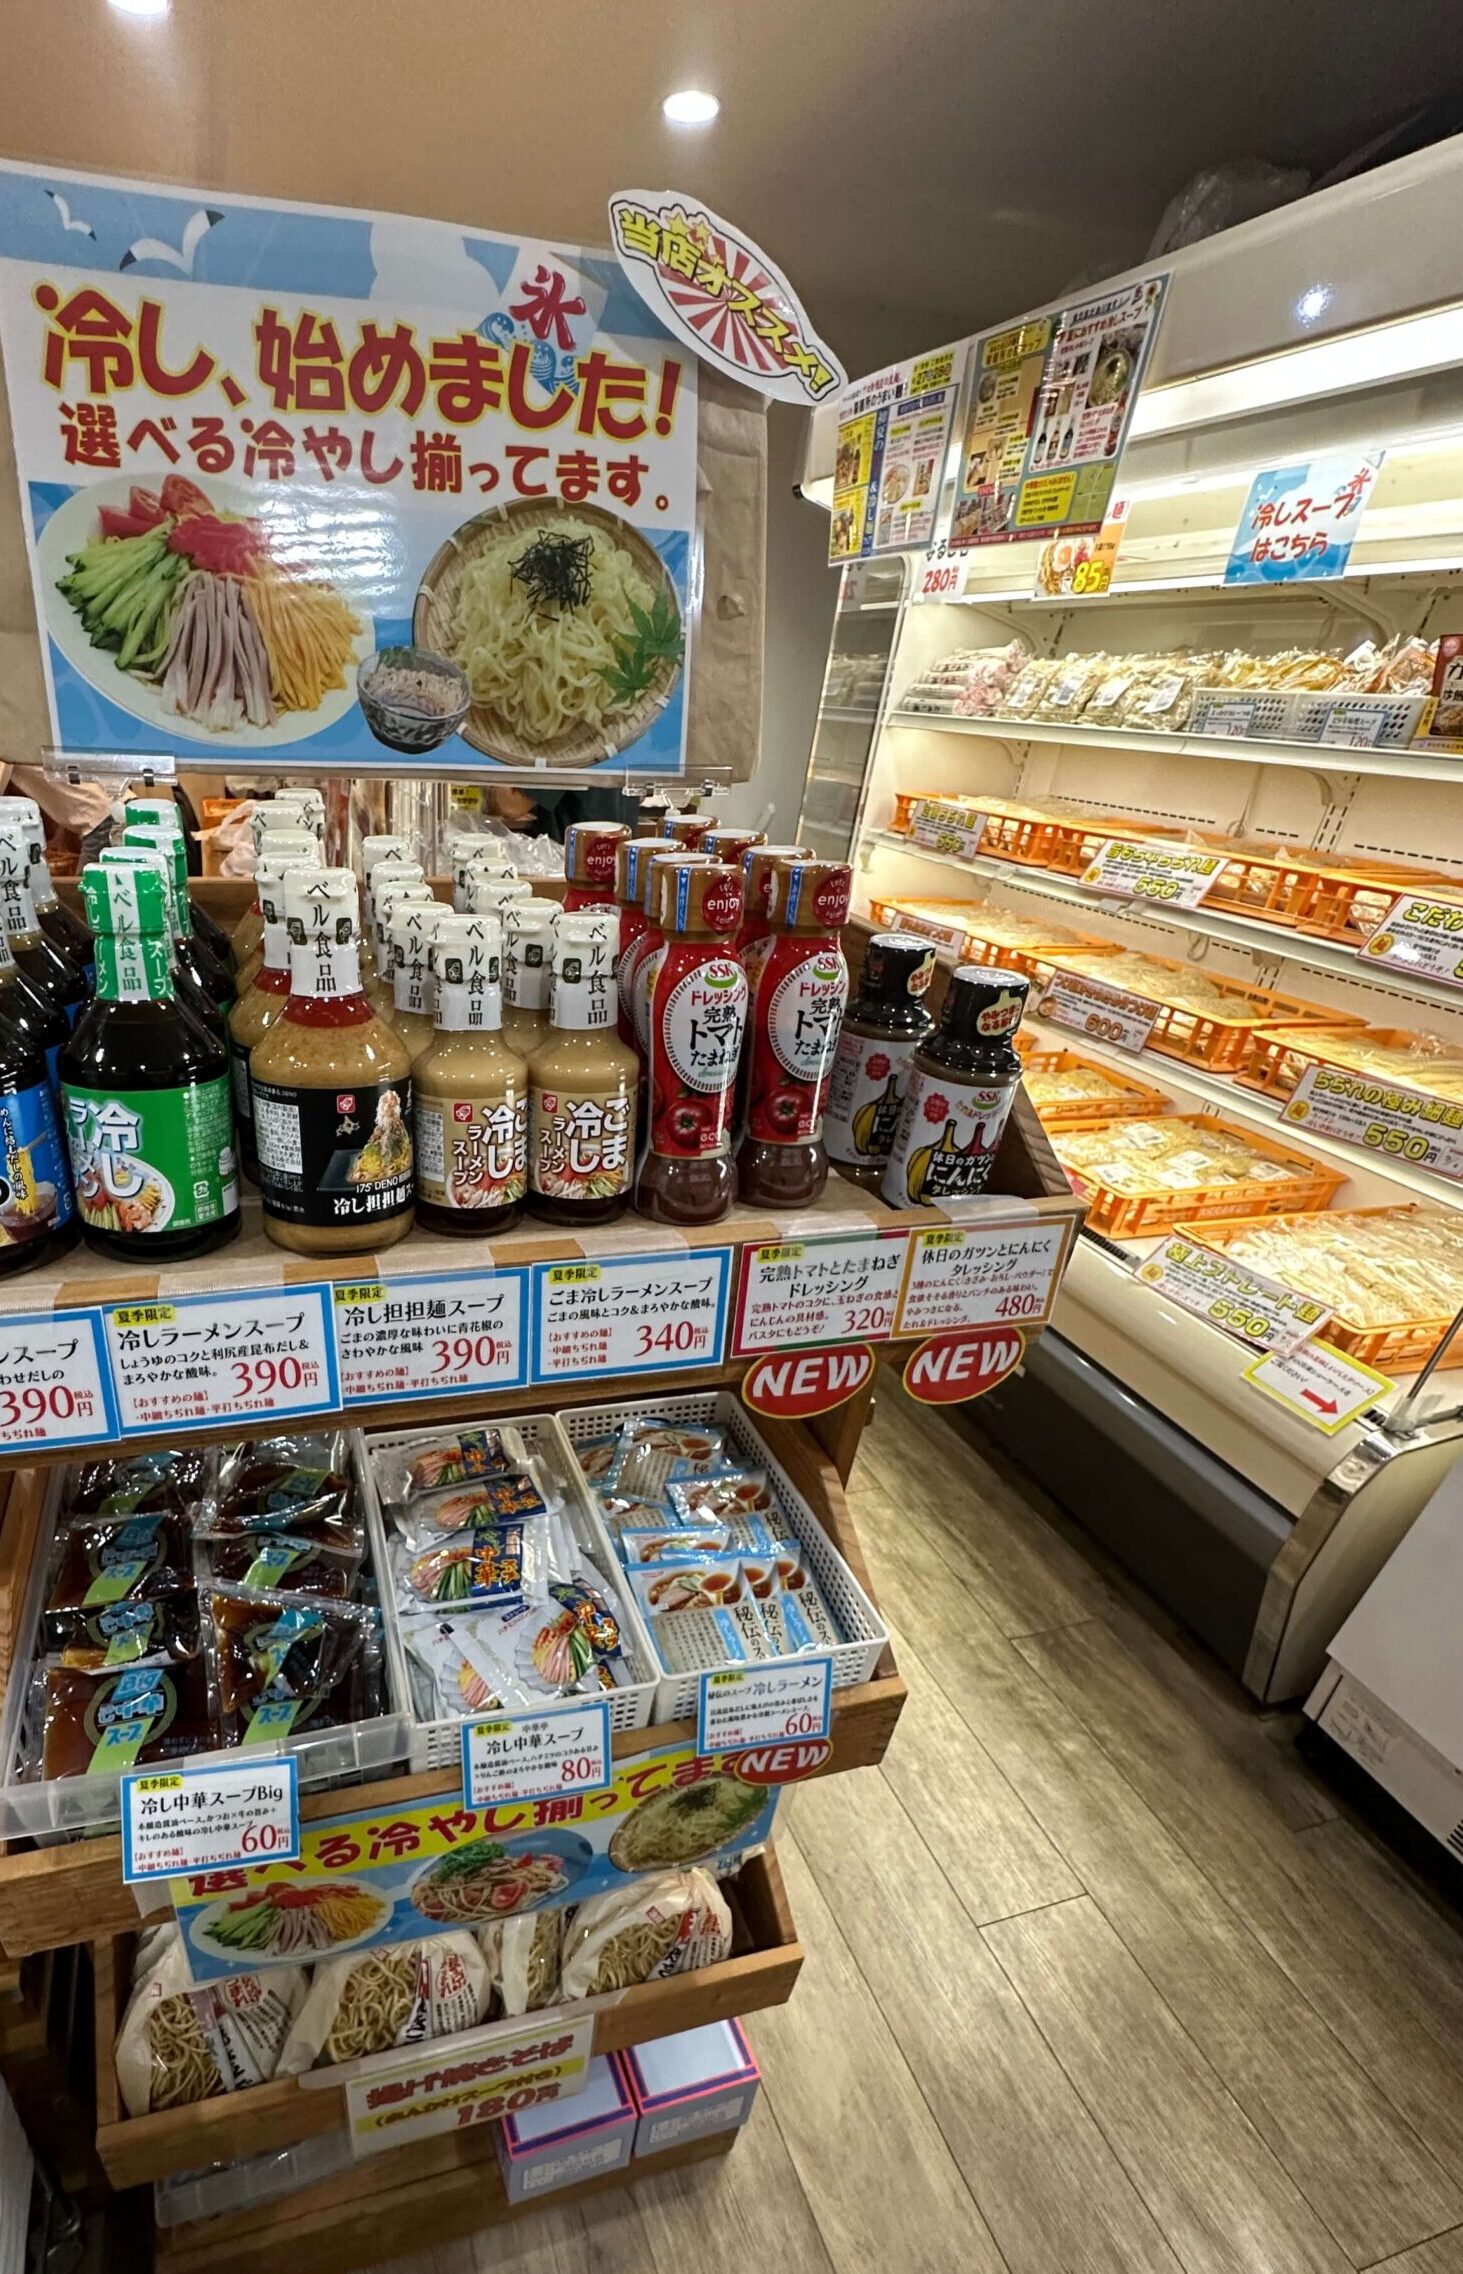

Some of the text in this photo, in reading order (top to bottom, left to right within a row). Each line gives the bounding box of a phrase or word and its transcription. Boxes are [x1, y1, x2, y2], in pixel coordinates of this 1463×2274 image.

[508, 270, 586, 353] 氷
[34, 281, 680, 437] 冷し、始めました!
[58, 402, 671, 512] 選べる冷やし揃ってます。
[1251, 492, 1355, 531] 冷しスープ
[1250, 531, 1329, 563] はこちら
[922, 568, 950, 594] 280
[1071, 560, 1105, 594] 85
[706, 896, 741, 912] enjoy
[1133, 875, 1180, 900] 550
[113, 888, 143, 992] ベル食品
[306, 880, 337, 993] ベル食品
[406, 912, 425, 1009] ベル食品
[465, 920, 487, 1027] ベル食品
[587, 922, 609, 1025] ベル食品
[799, 980, 847, 999] ドレッシン
[689, 1016, 744, 1050] トマト
[1084, 1012, 1124, 1041] 600
[87, 1101, 144, 1199] 冷し
[481, 1103, 516, 1180] 冷し
[551, 1116, 568, 1175] ラーメン
[564, 1100, 605, 1174] 冷し
[602, 1096, 632, 1171] ごま
[1362, 1121, 1430, 1161] 550
[452, 1140, 469, 1187] スープ
[467, 1125, 484, 1186] ラーメン
[538, 1128, 553, 1173] スープ
[758, 1253, 901, 1284] 完熟トマトとたまねぎ
[922, 1239, 1051, 1265] 休日のガツンとにんにく
[950, 1258, 1018, 1278] タレッシング
[549, 1275, 713, 1306] ごま冷しラーメンスープ
[552, 1267, 598, 1281] 夏季限定
[789, 1275, 869, 1299] ドレッシング
[335, 1286, 384, 1301] 夏季限定
[344, 1293, 505, 1327] 冷し担担麺スープ
[994, 1293, 1036, 1318] 480
[116, 1305, 172, 1324] 夏季限定
[1208, 1298, 1271, 1338] 550
[117, 1311, 305, 1352] 冷しラーメンスープ
[341, 1342, 424, 1360] さわやかな風味
[911, 1340, 1020, 1385] NEW
[751, 1355, 871, 1398] NEW
[752, 1675, 824, 1697] 冷しラーメン
[258, 1703, 292, 1724] スープ
[784, 1712, 813, 1736] 60
[106, 1722, 143, 1747] スープ
[486, 1726, 585, 1755] 冷し中華スープ
[561, 1756, 592, 1782] 80
[741, 1745, 831, 1774] NEW
[139, 1775, 181, 1791] 夏季限定
[140, 1784, 284, 1816] 冷し中華スープBig
[241, 1823, 277, 1853] 60
[365, 2033, 575, 2110] 揚げ焼きそば
